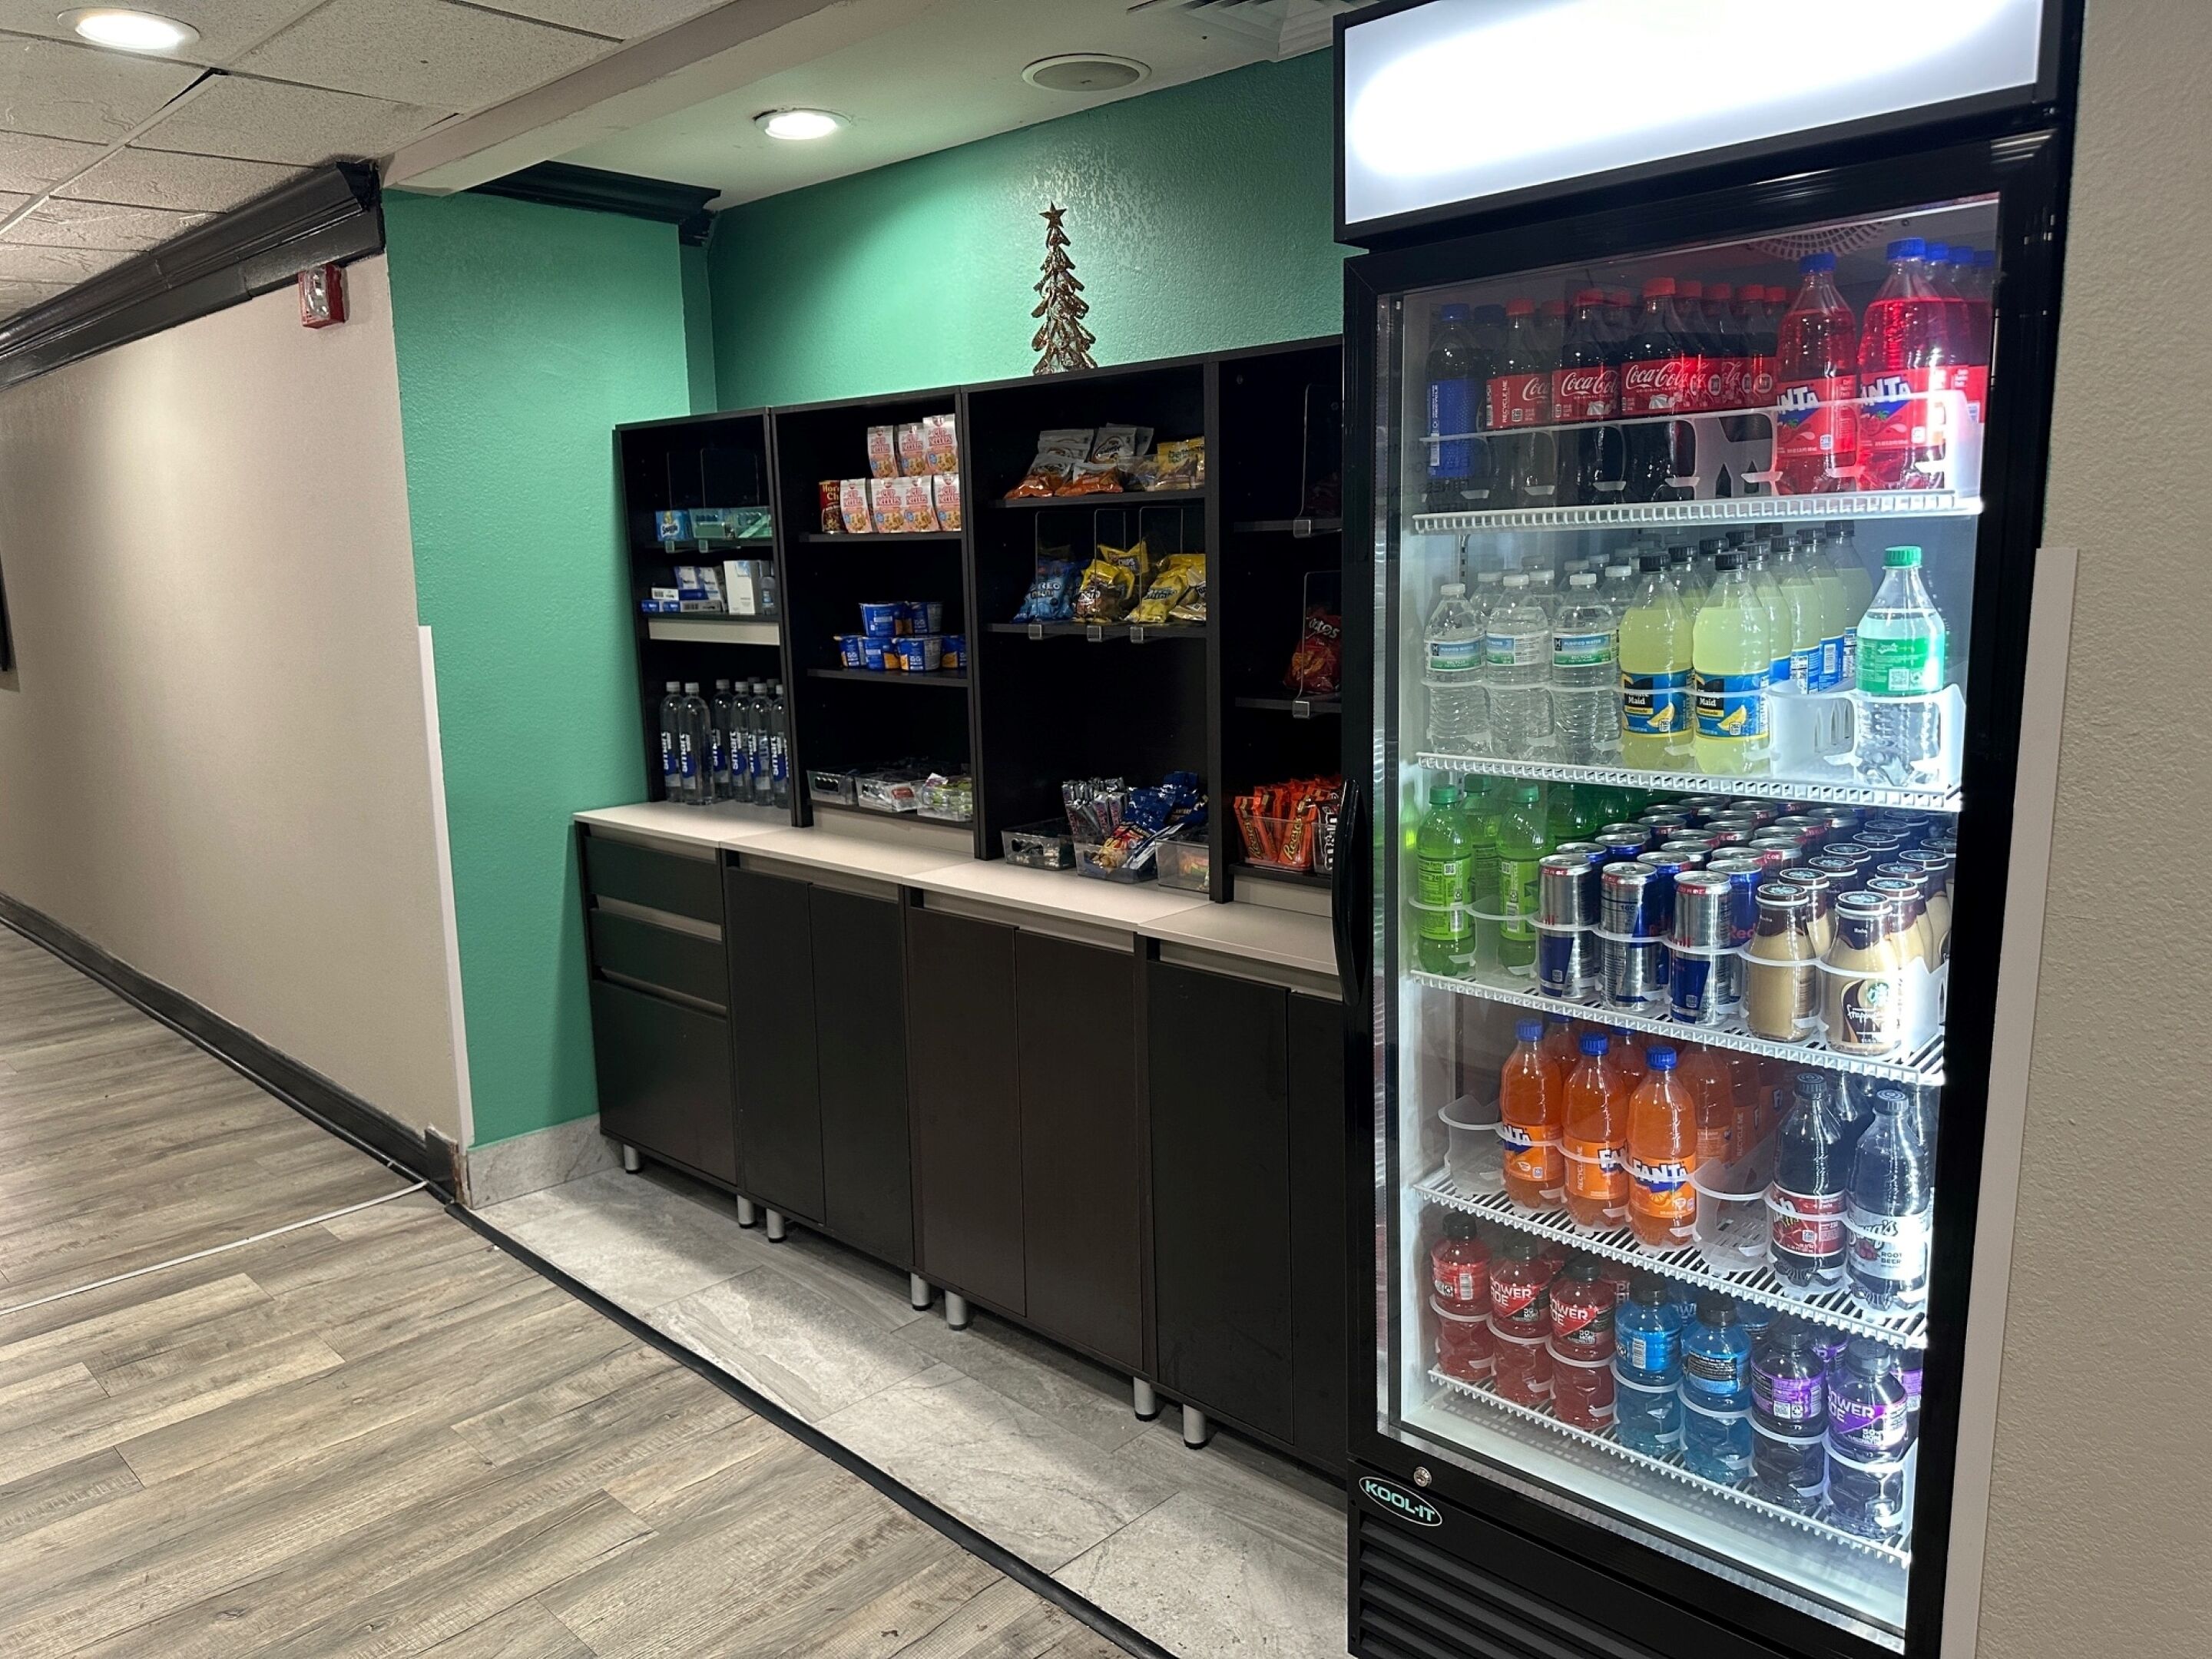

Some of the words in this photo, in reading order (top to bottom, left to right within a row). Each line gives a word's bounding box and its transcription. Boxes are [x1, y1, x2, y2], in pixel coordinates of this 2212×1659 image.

[1625, 361, 1690, 390] Coca-Cola
[1628, 696, 1646, 705] Maid
[1700, 697, 1717, 707] Maid
[1632, 1157, 1688, 1184] FANTA
